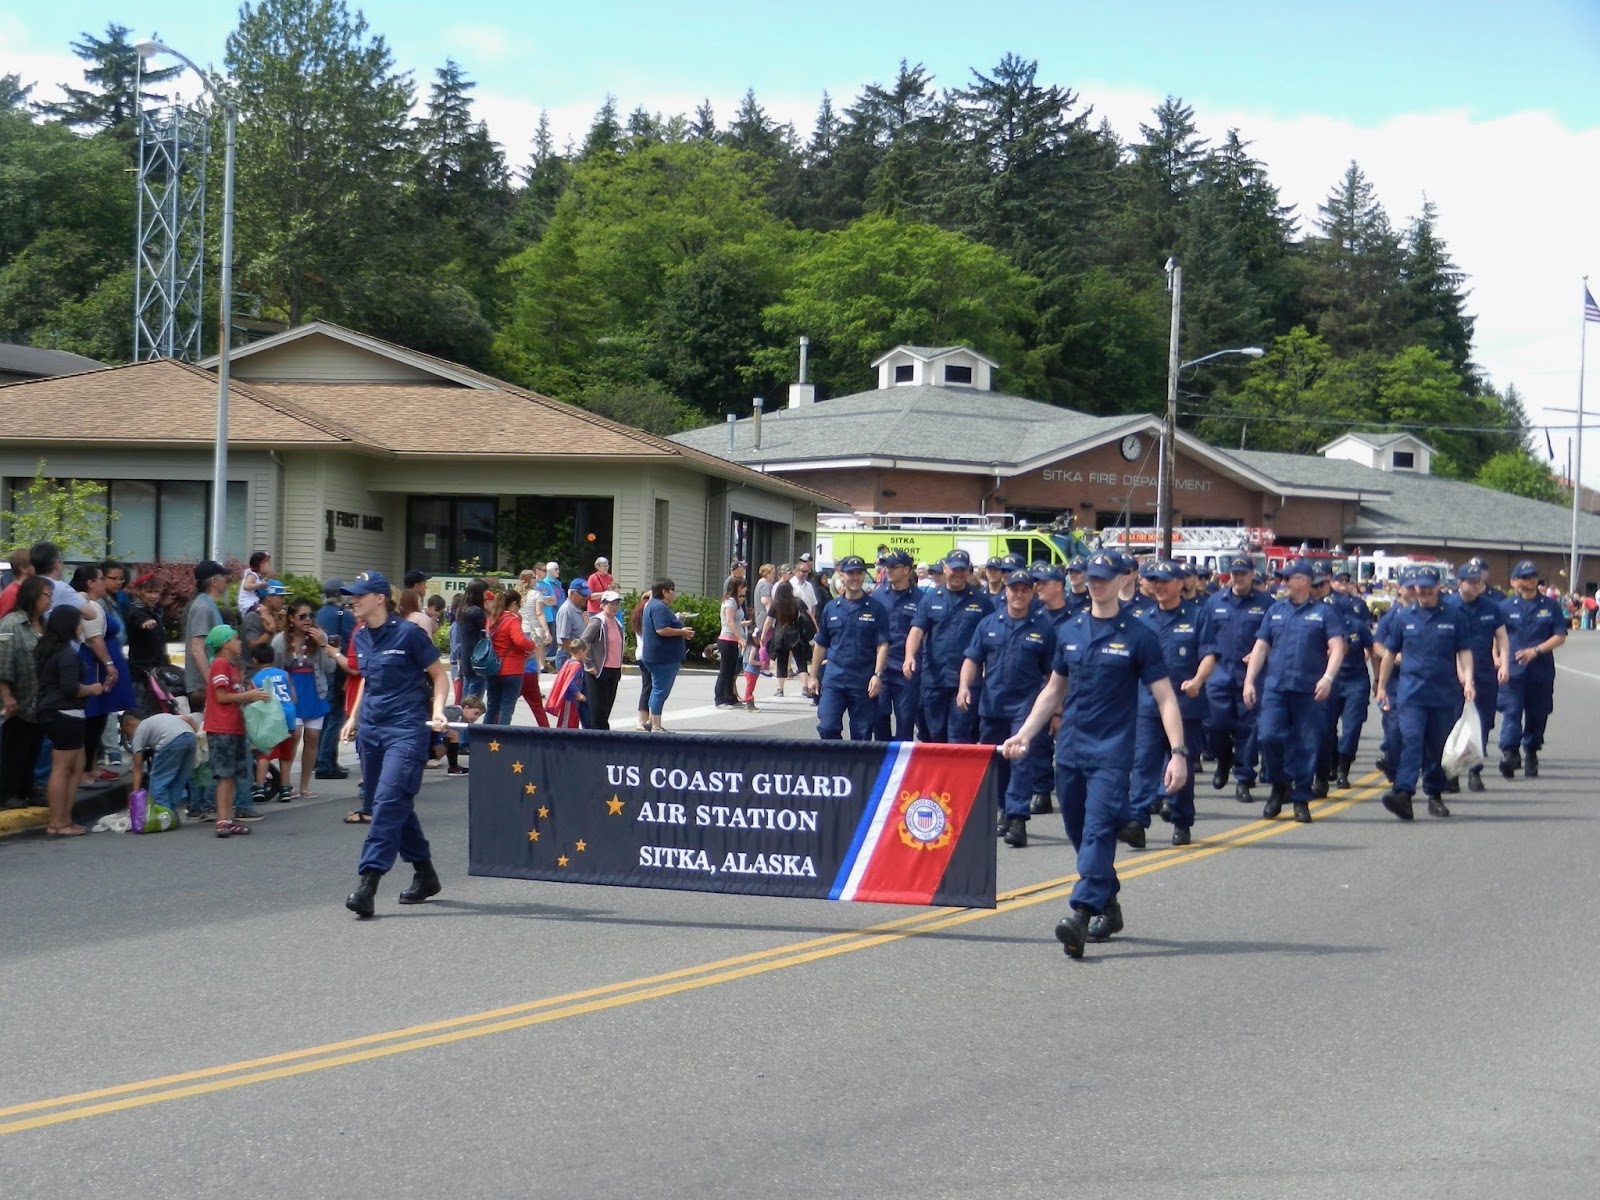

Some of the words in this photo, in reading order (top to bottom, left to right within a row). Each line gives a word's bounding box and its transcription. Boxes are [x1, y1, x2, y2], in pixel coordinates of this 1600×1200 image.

[1042, 469, 1083, 483] SITKA
[1088, 472, 1117, 485] FIRE
[1122, 474, 1213, 492] DEPAMENT
[606, 765, 641, 787] US
[650, 767, 743, 793] COAST
[751, 773, 852, 798] GUARD
[637, 801, 687, 825] AIR
[695, 804, 818, 832] STATION
[639, 845, 717, 876] SITKA,
[720, 851, 817, 878] ALASKA
